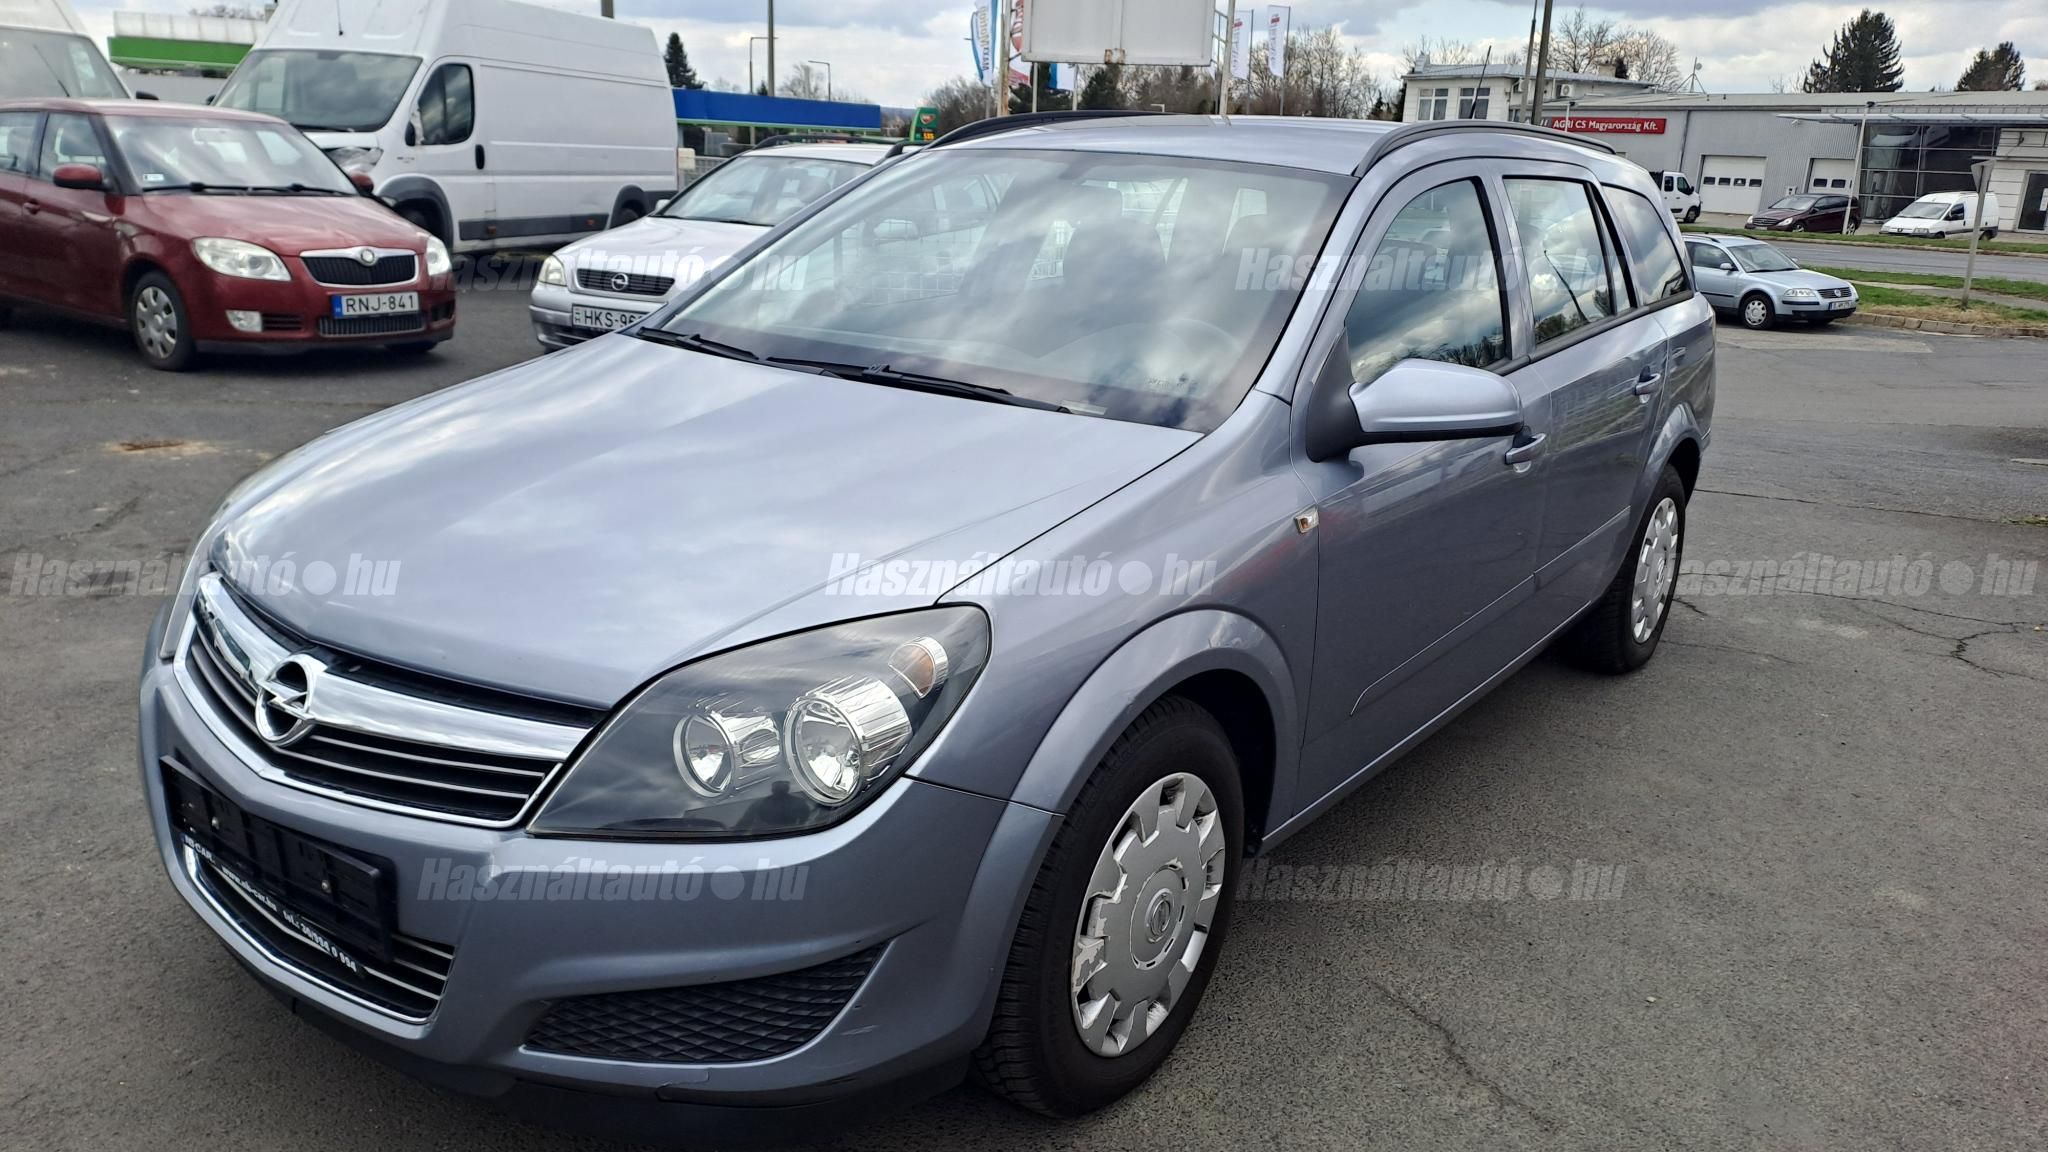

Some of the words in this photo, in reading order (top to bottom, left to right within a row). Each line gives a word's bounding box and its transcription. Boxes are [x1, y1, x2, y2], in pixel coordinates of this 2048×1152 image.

[1575, 120, 1587, 129] CS
[1589, 120, 1641, 132] Magyarország
[1643, 122, 1658, 131] Kft.
[345, 295, 414, 313] RNJ-841
[583, 309, 643, 328] HKS-96
